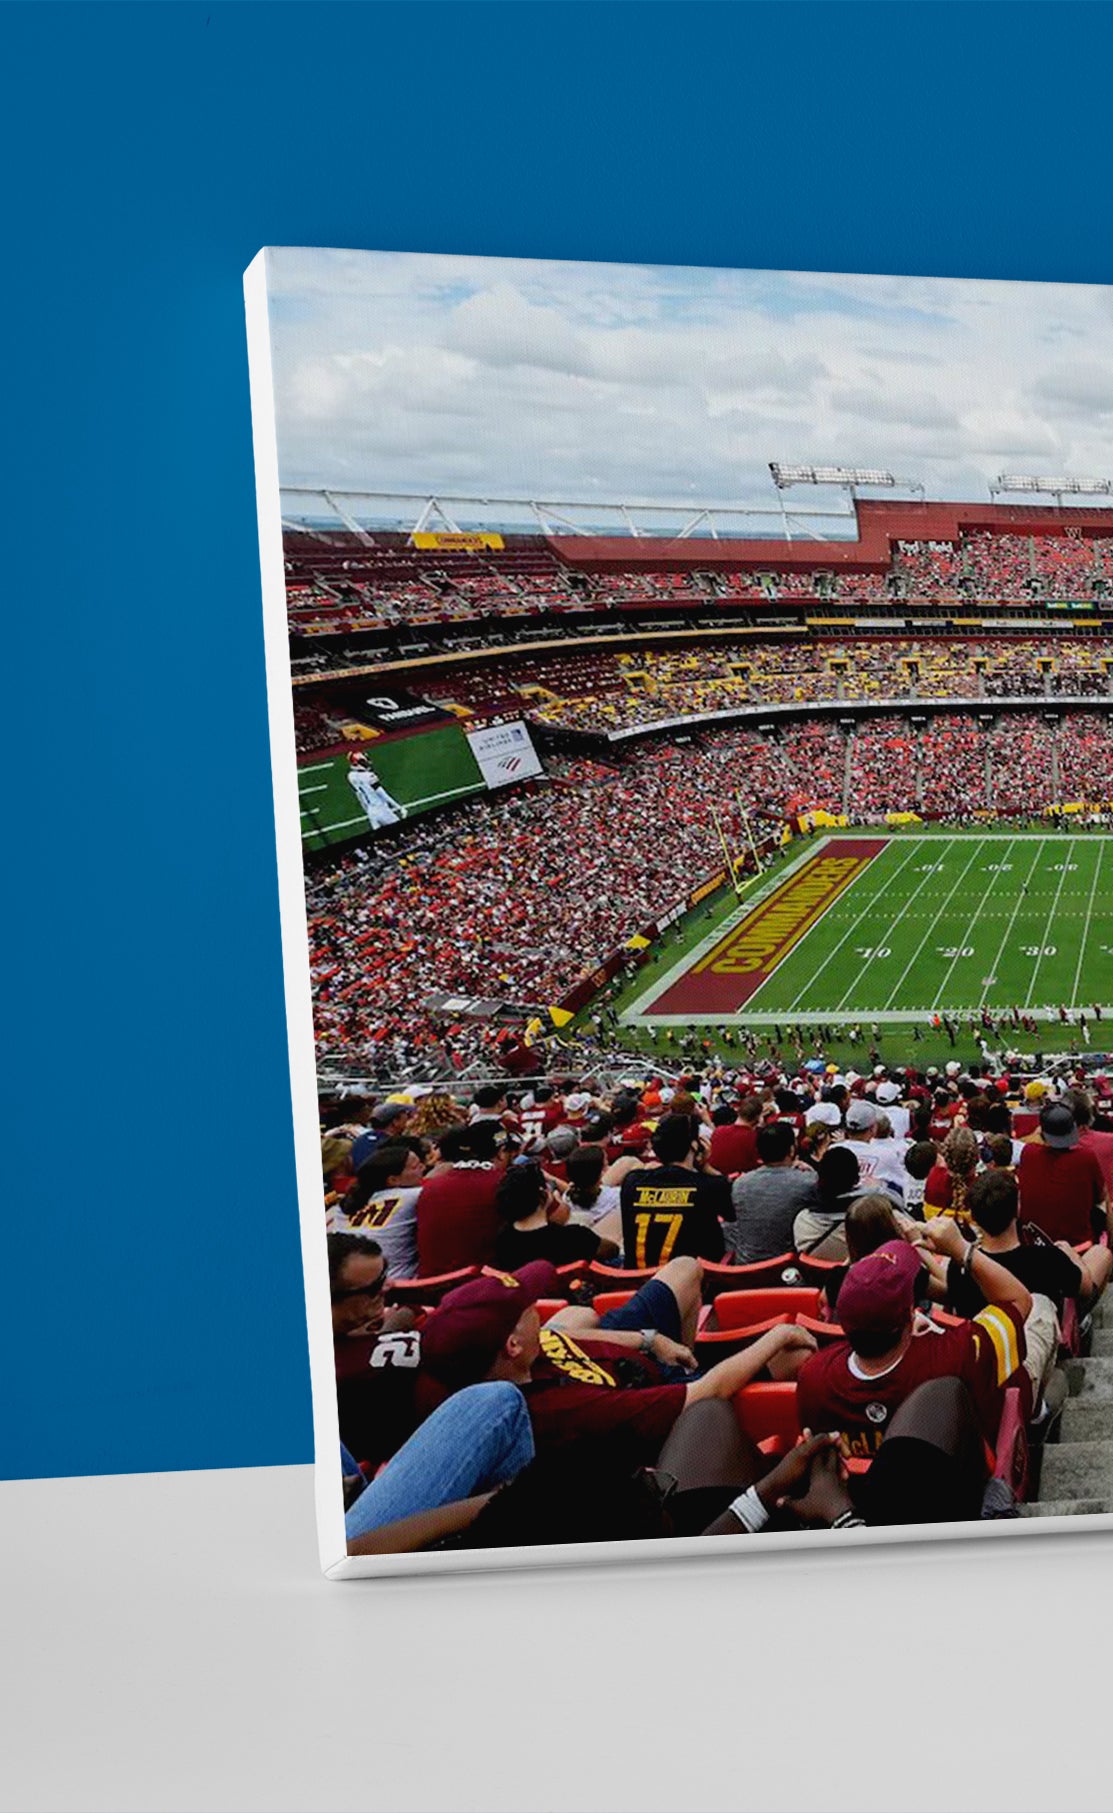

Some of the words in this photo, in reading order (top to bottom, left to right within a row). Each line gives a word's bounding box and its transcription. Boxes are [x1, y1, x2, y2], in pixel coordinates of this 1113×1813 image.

[711, 857, 859, 974] COMMANDERS
[862, 948, 891, 958] 10
[942, 947, 974, 957] 20
[1026, 946, 1057, 957] 30
[634, 1213, 683, 1269] 17
